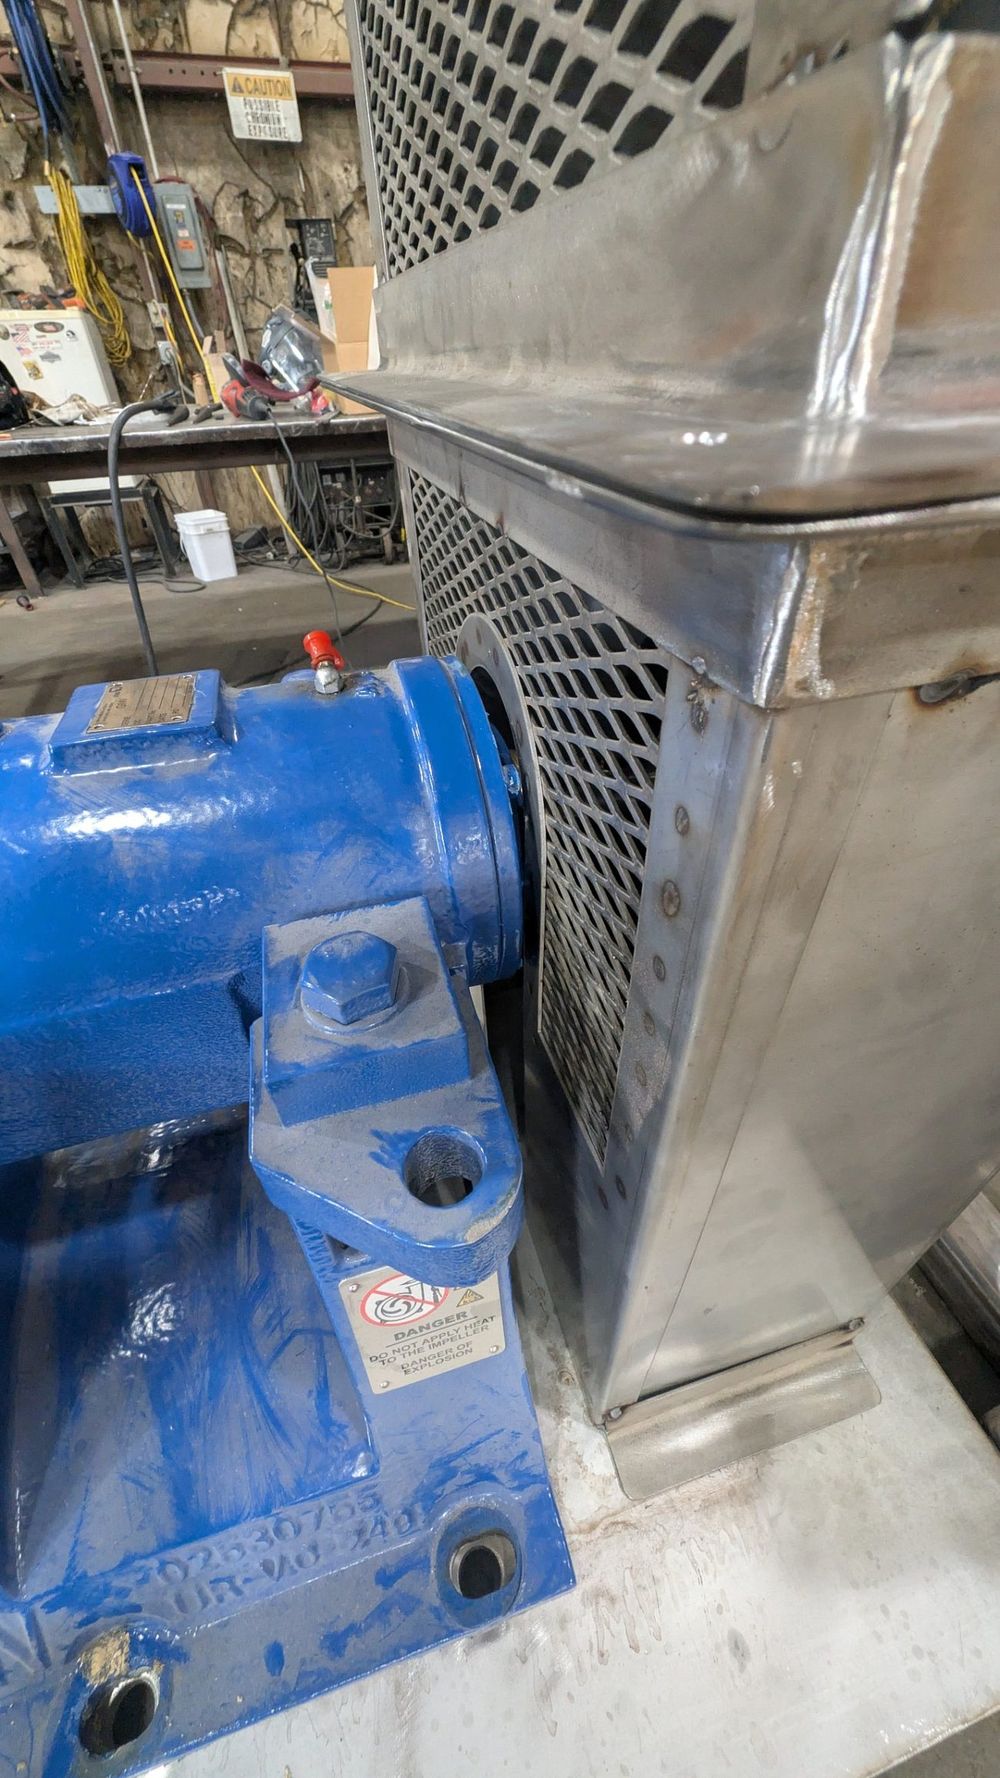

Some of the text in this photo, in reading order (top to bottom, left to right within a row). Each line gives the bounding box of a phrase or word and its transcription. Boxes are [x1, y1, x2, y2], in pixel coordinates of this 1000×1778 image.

[245, 77, 292, 97] CAUTION
[369, 1315, 497, 1363] DO NOT APPLY HEAT
[393, 1311, 468, 1341] DANGER
[379, 1325, 489, 1366] TO THE IMPELLER
[401, 1341, 473, 1370] DANGER OF
[403, 1348, 473, 1376] EXPLOSION
